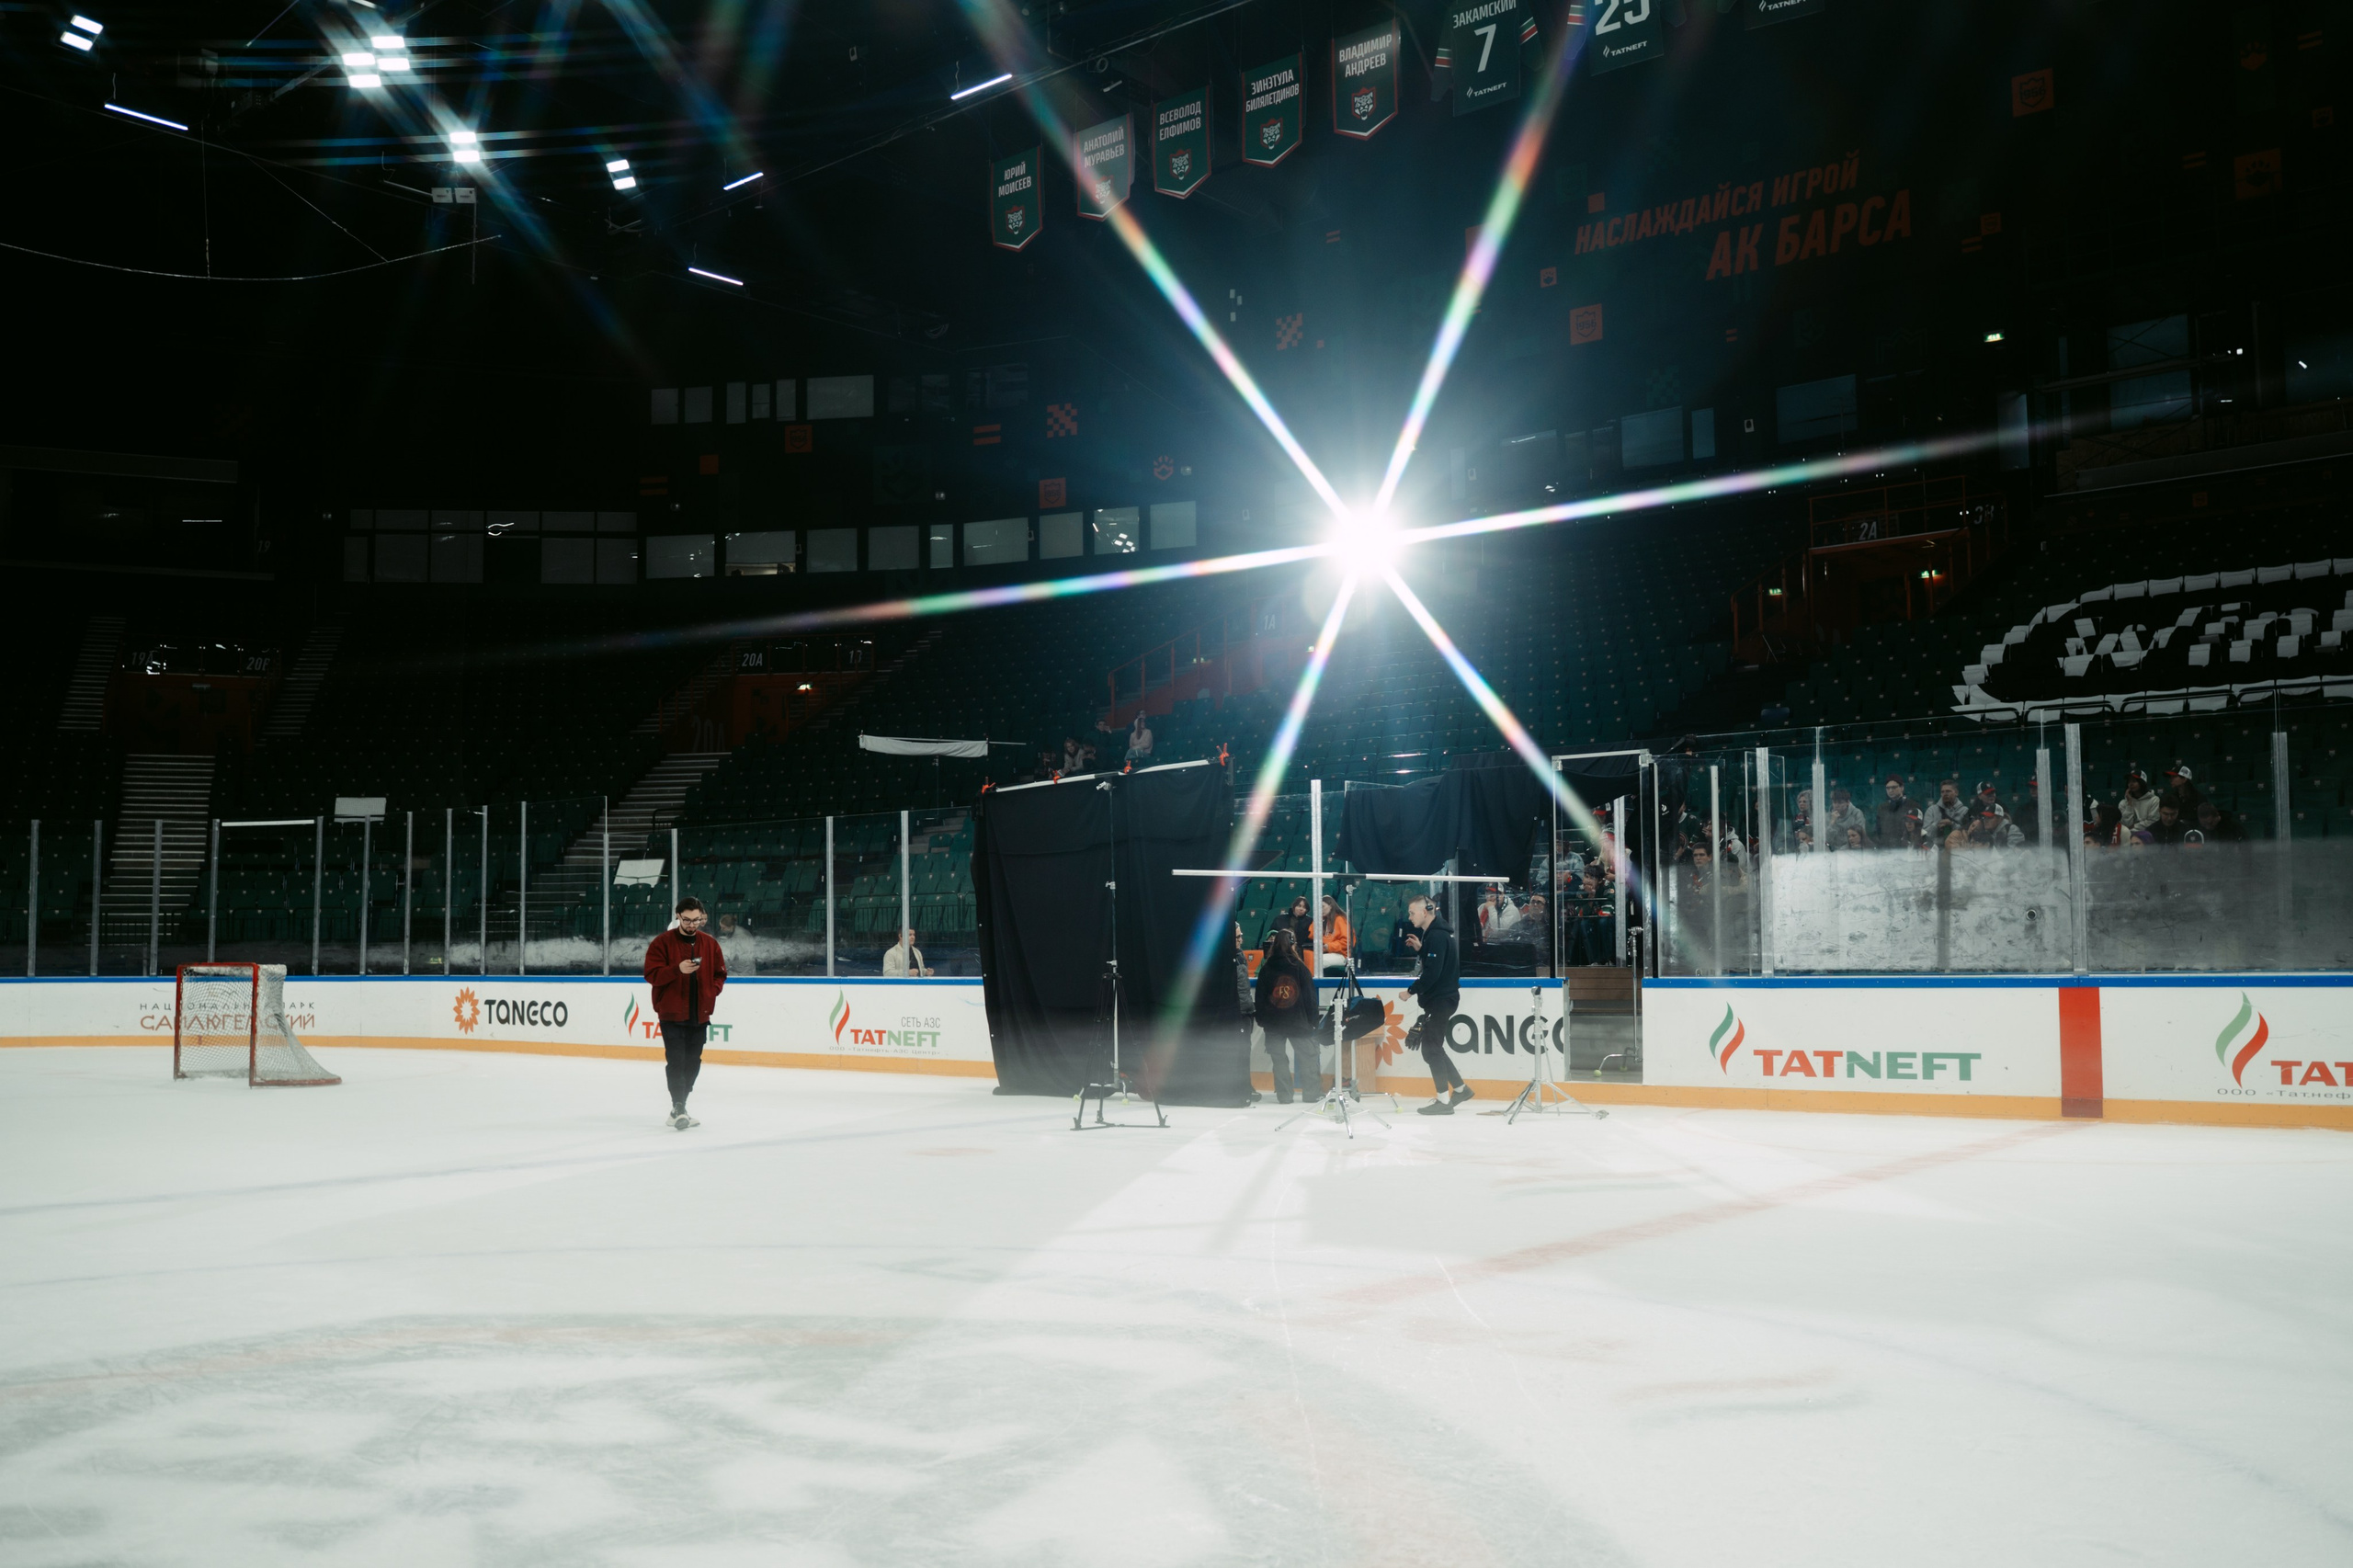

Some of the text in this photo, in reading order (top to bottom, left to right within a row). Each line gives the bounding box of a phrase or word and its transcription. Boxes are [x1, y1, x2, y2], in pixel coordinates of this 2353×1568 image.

[1338, 34, 1392, 62] ВЛАДИМИР
[1473, 23, 1496, 73] 7
[1610, 40, 1648, 56] TATNEFT
[1345, 52, 1386, 78] АНДРЕЕВ
[1251, 69, 1294, 96] ЗИНЭТУЛА
[1473, 82, 1507, 97] TATNEFT
[1245, 83, 1300, 113] БИЛЯЛЕТДИНОВ
[1159, 100, 1201, 125] ВСЕВОЛОД
[1084, 126, 1124, 153] АНАТОЛИЙ
[1159, 117, 1201, 141] ЕЛФИМОВ
[1084, 143, 1125, 168] МУРАВЬЕВ
[1004, 161, 1026, 181] ЮРИЙ
[998, 176, 1032, 198] МОИСЕЕВ
[1574, 149, 1860, 256] НАСЛАЖДАЙСЯ ИГРОЙ
[1704, 187, 1912, 281] АК БАРСА
[1859, 521, 1878, 541] 2A
[1264, 614, 1276, 631] 1A
[741, 653, 763, 667] 20A
[483, 999, 568, 1028] TANECO
[900, 1017, 941, 1028] СЕТЬ АЗС
[642, 1021, 733, 1042] TAFT
[850, 1028, 941, 1048] TATNEFT
[1753, 1049, 1982, 1081] TATNEFT
